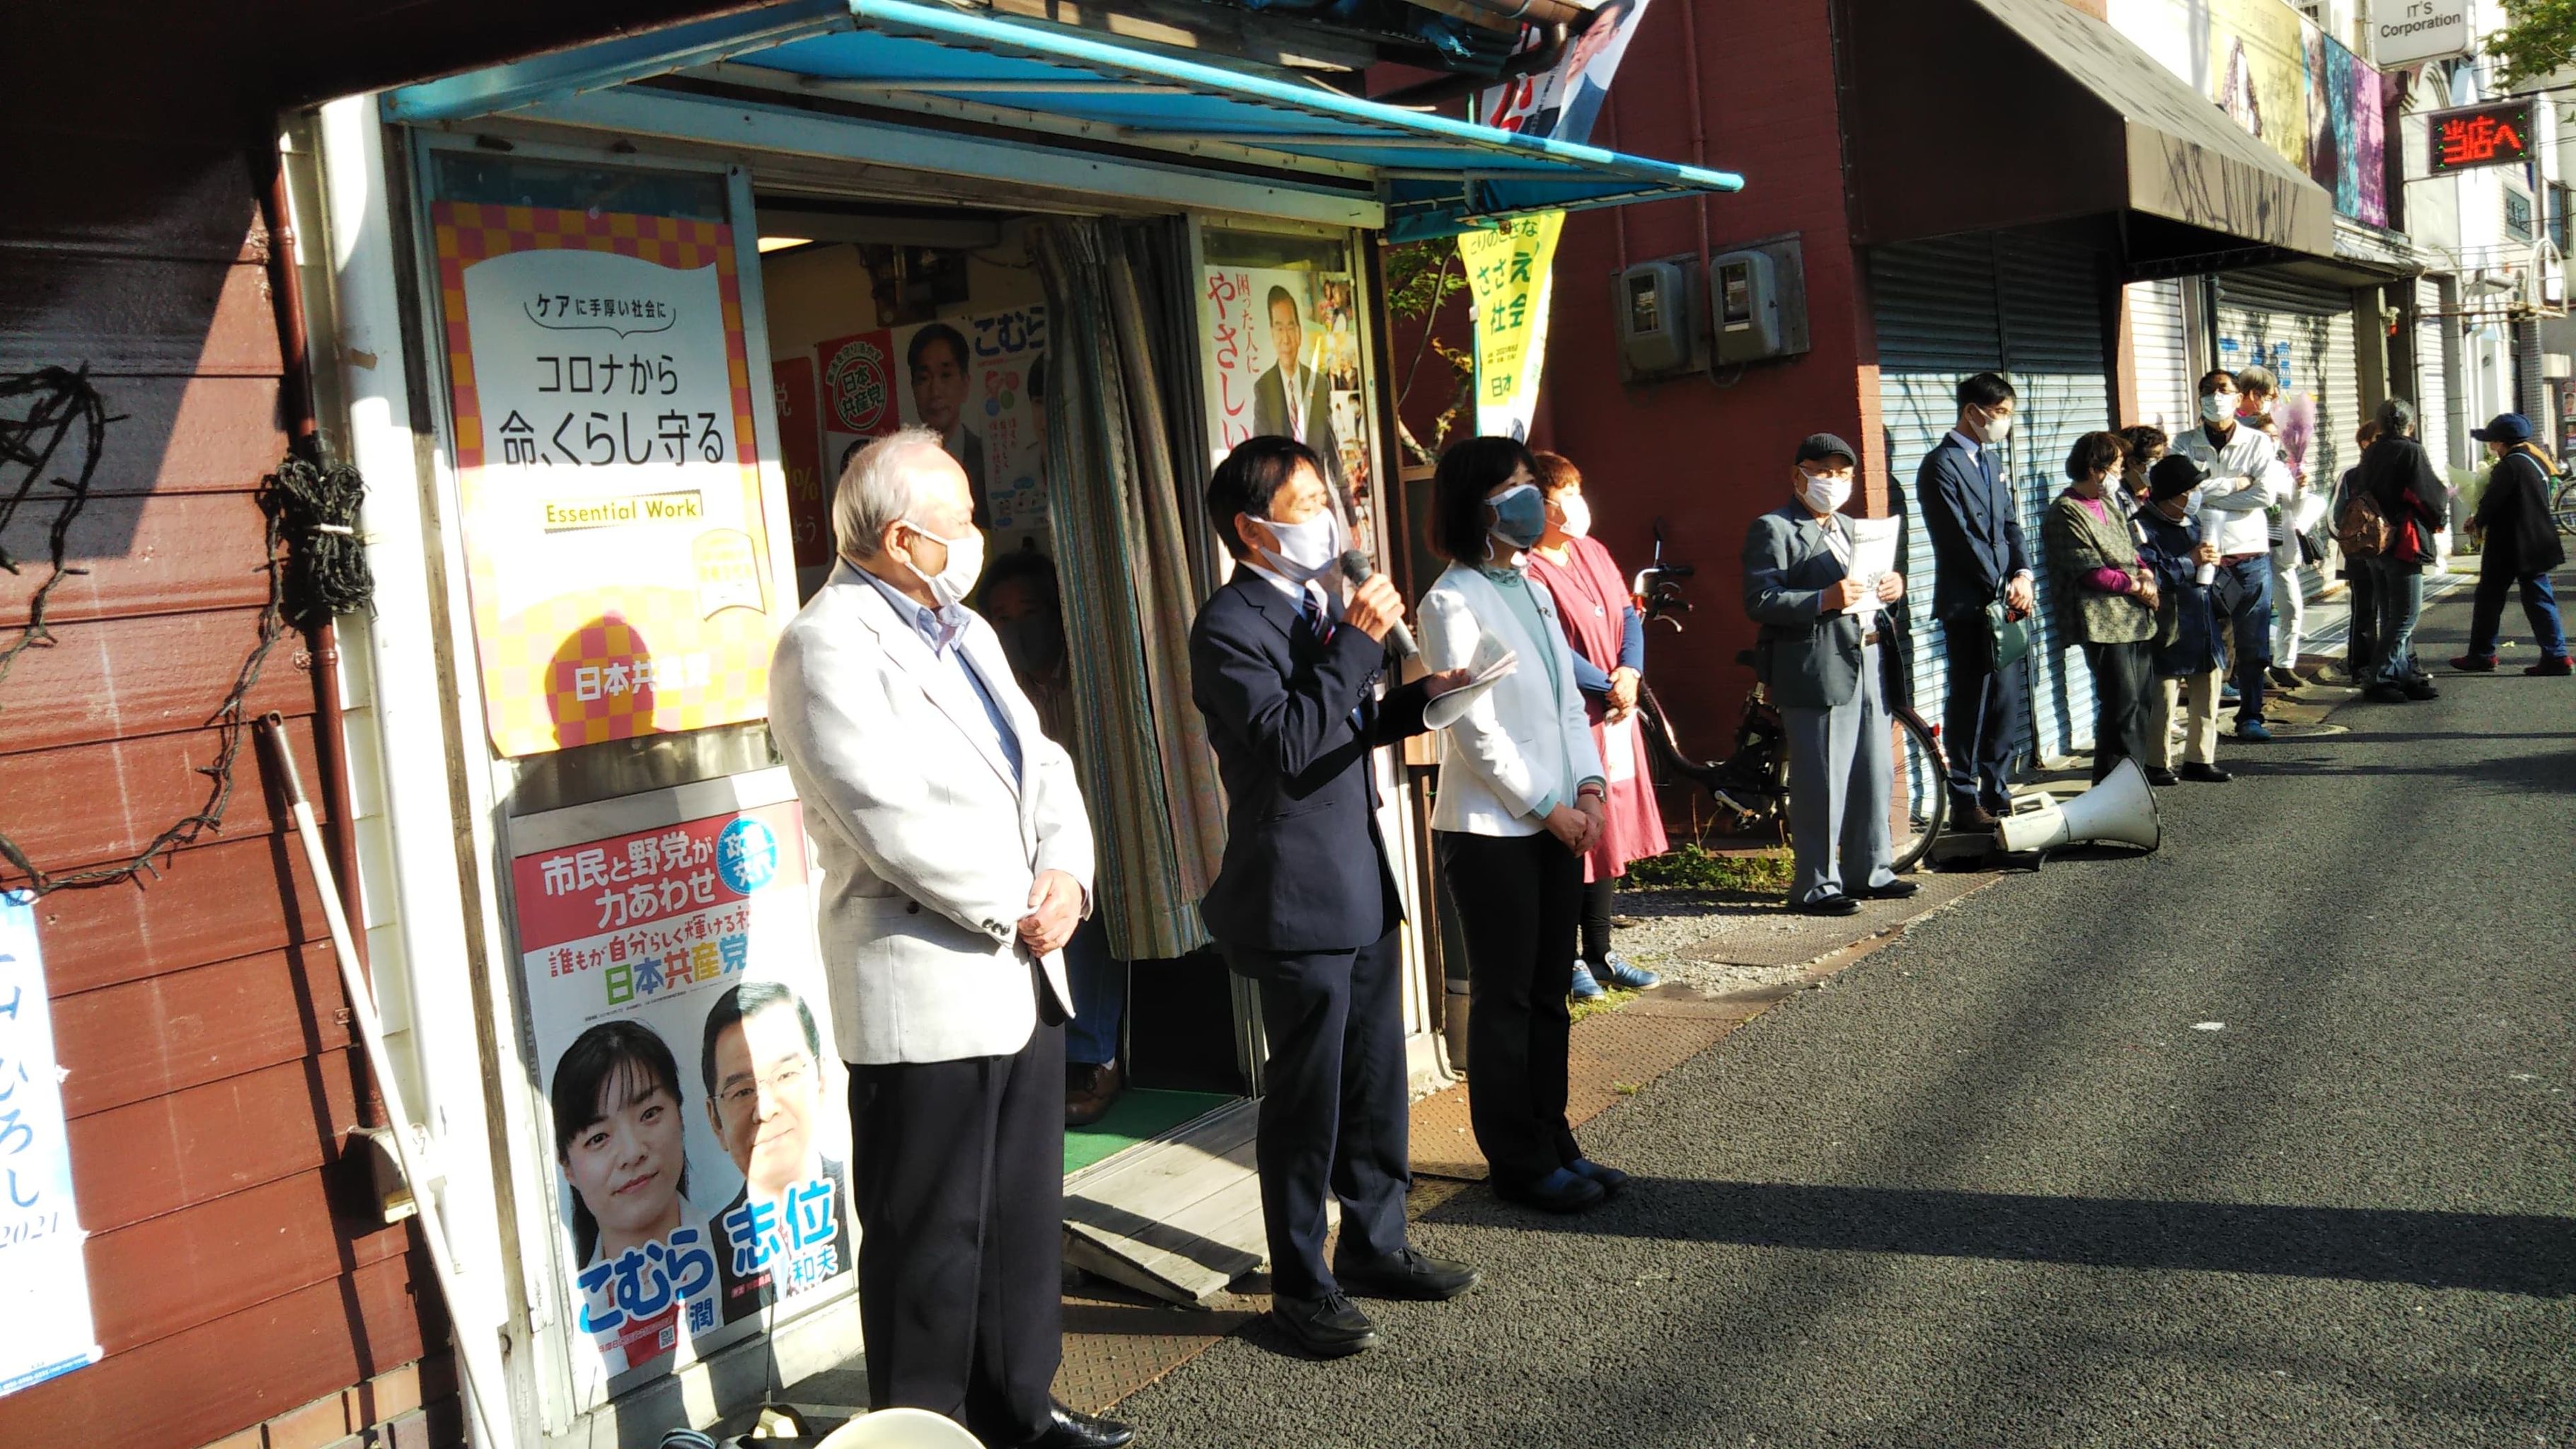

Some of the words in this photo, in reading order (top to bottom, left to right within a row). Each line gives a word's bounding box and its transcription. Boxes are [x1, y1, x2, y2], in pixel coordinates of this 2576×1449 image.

[2381, 13, 2461, 38] Corporation
[2406, 1, 2433, 18] IT'S
[2442, 115, 2522, 163] 当店へ
[537, 294, 666, 318] ケアに手厚い社会に
[1237, 274, 1259, 374] 困った人に
[536, 354, 678, 395] コロナから
[842, 366, 870, 393] 日本
[1208, 272, 1249, 451] やさしい
[842, 384, 884, 415] 共産党
[499, 409, 724, 470] 命、くらし守る
[546, 501, 636, 523] Essential
[645, 499, 697, 518] Work
[541, 831, 713, 896] 市民と野党が
[595, 867, 715, 928] 力あわせ
[605, 933, 748, 1005] 日本共産党
[0, 1211, 58, 1249] 2021
[727, 1180, 836, 1272] 志位
[577, 1228, 714, 1333] こむら
[792, 1248, 836, 1286] 和夫
[691, 1298, 714, 1332] 潤
